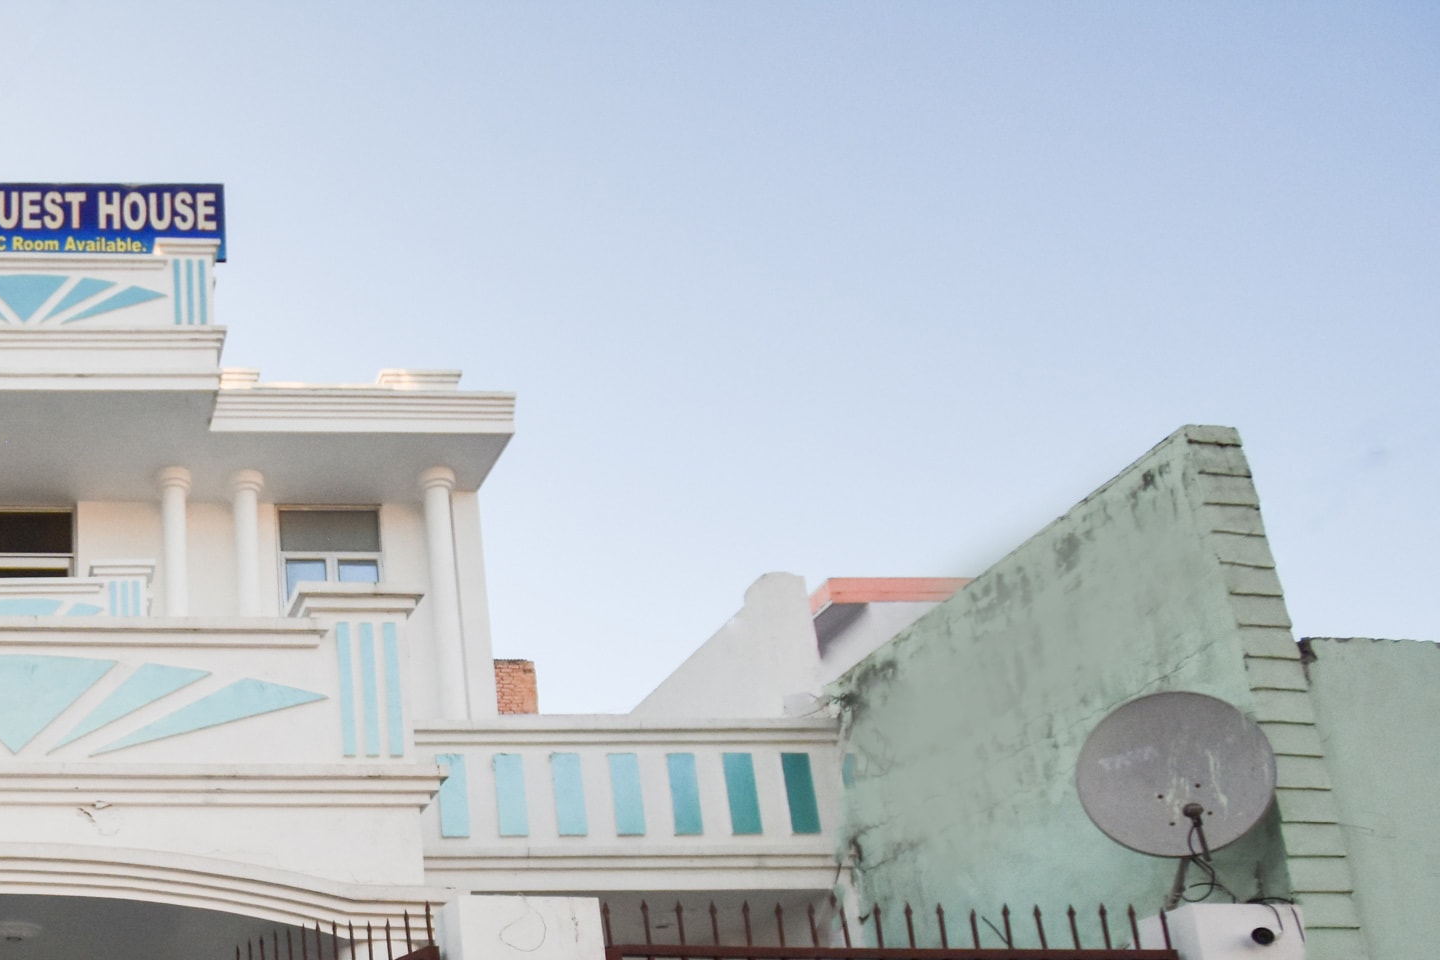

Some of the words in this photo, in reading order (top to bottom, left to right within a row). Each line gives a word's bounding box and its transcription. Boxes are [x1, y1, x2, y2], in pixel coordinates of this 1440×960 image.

[98, 191, 217, 231] HOUSE
[12, 236, 59, 251] Room
[64, 236, 147, 252] Available.
